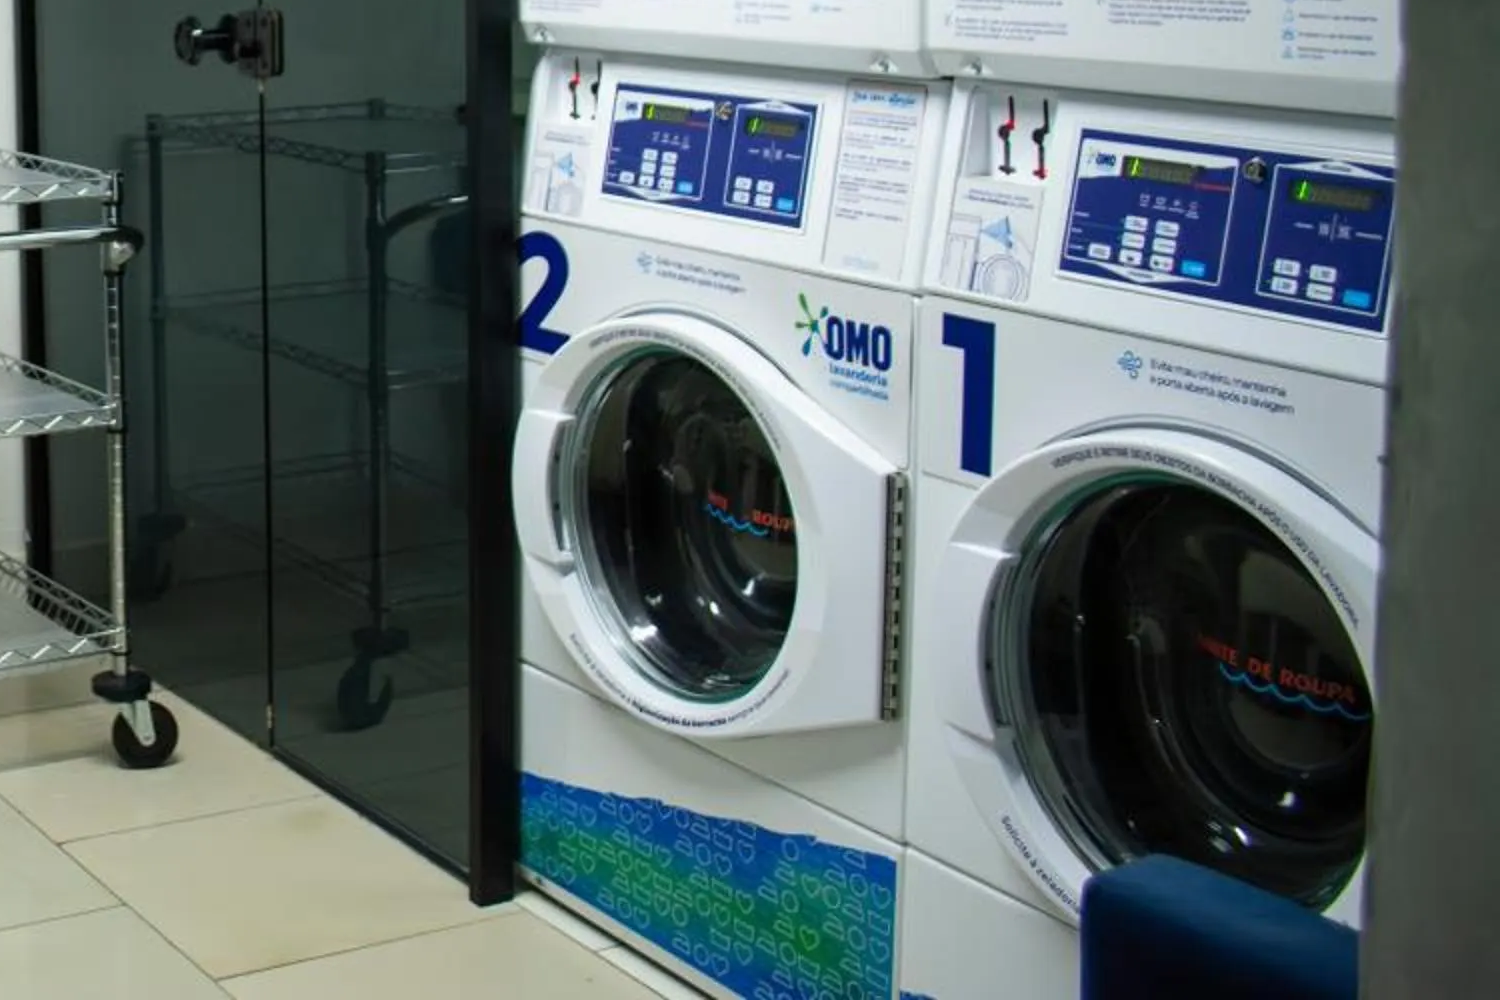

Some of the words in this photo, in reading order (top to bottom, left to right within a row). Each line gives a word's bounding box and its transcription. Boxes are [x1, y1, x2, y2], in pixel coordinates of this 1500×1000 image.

[517, 230, 572, 355] 2
[823, 315, 893, 372] OMO
[942, 312, 996, 478] 1
